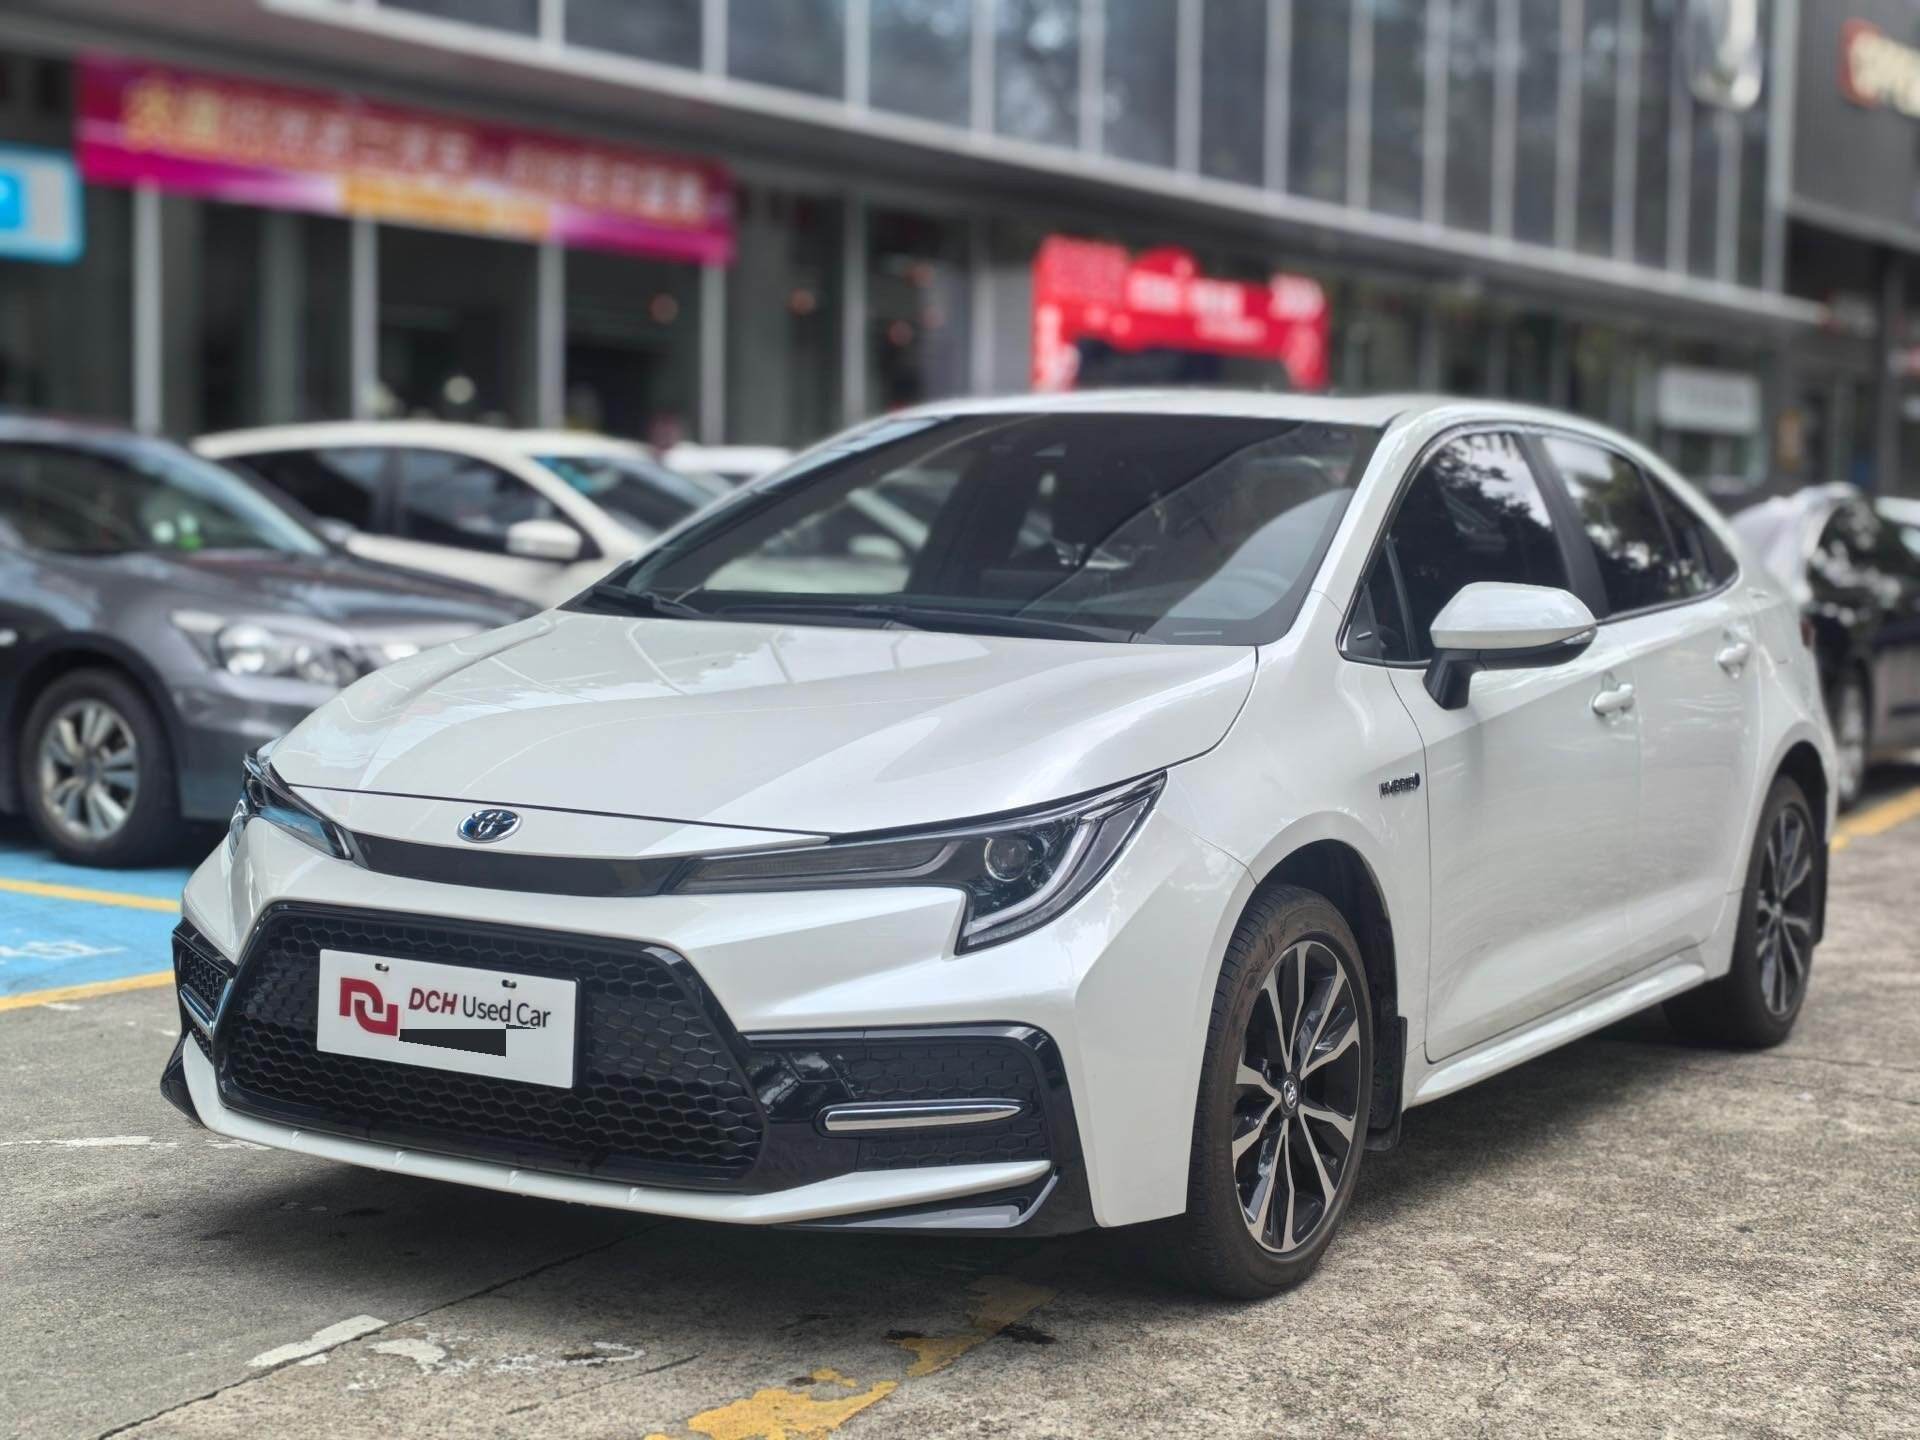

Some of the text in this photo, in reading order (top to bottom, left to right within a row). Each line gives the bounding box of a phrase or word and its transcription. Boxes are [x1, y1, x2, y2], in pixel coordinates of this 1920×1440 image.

[408, 987, 551, 1028] DCH Used Car
